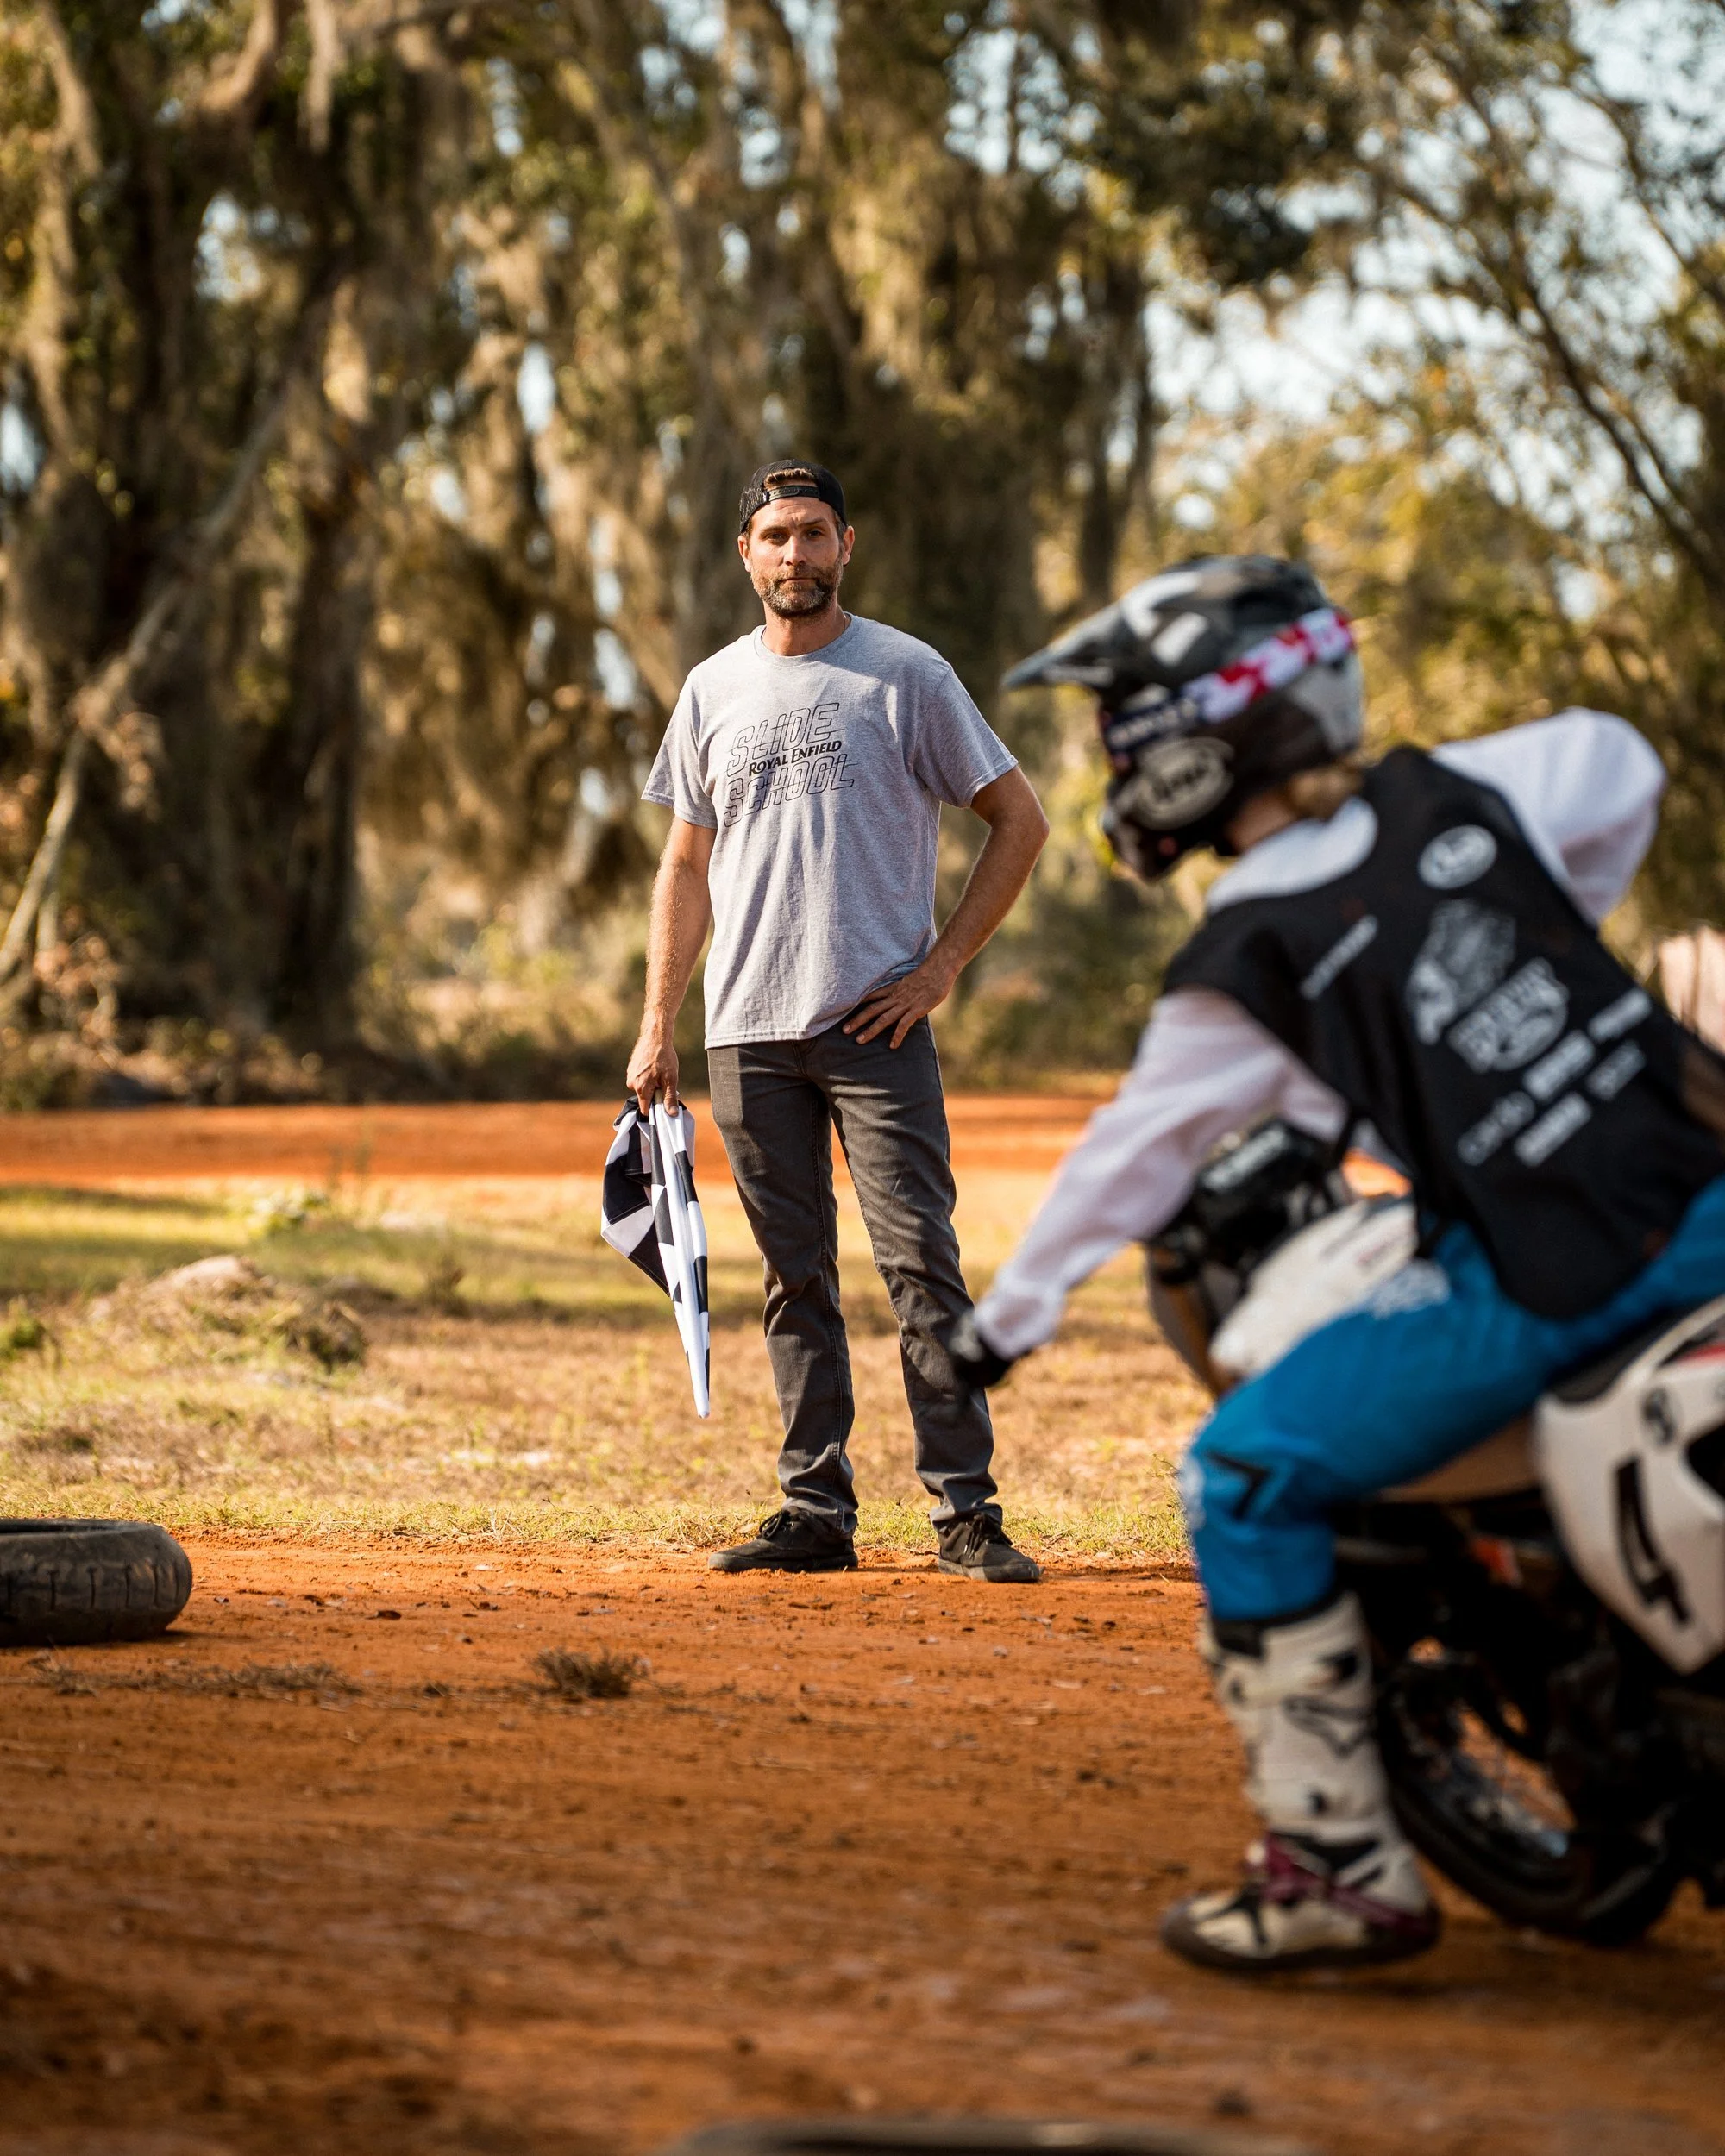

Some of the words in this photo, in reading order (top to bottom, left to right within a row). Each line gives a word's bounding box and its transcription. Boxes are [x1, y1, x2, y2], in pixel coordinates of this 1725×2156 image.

[726, 702, 840, 777] SLIDE
[749, 754, 788, 777] ROYAL
[791, 740, 843, 763] ENFIELD
[724, 754, 855, 827] SCHOOL
